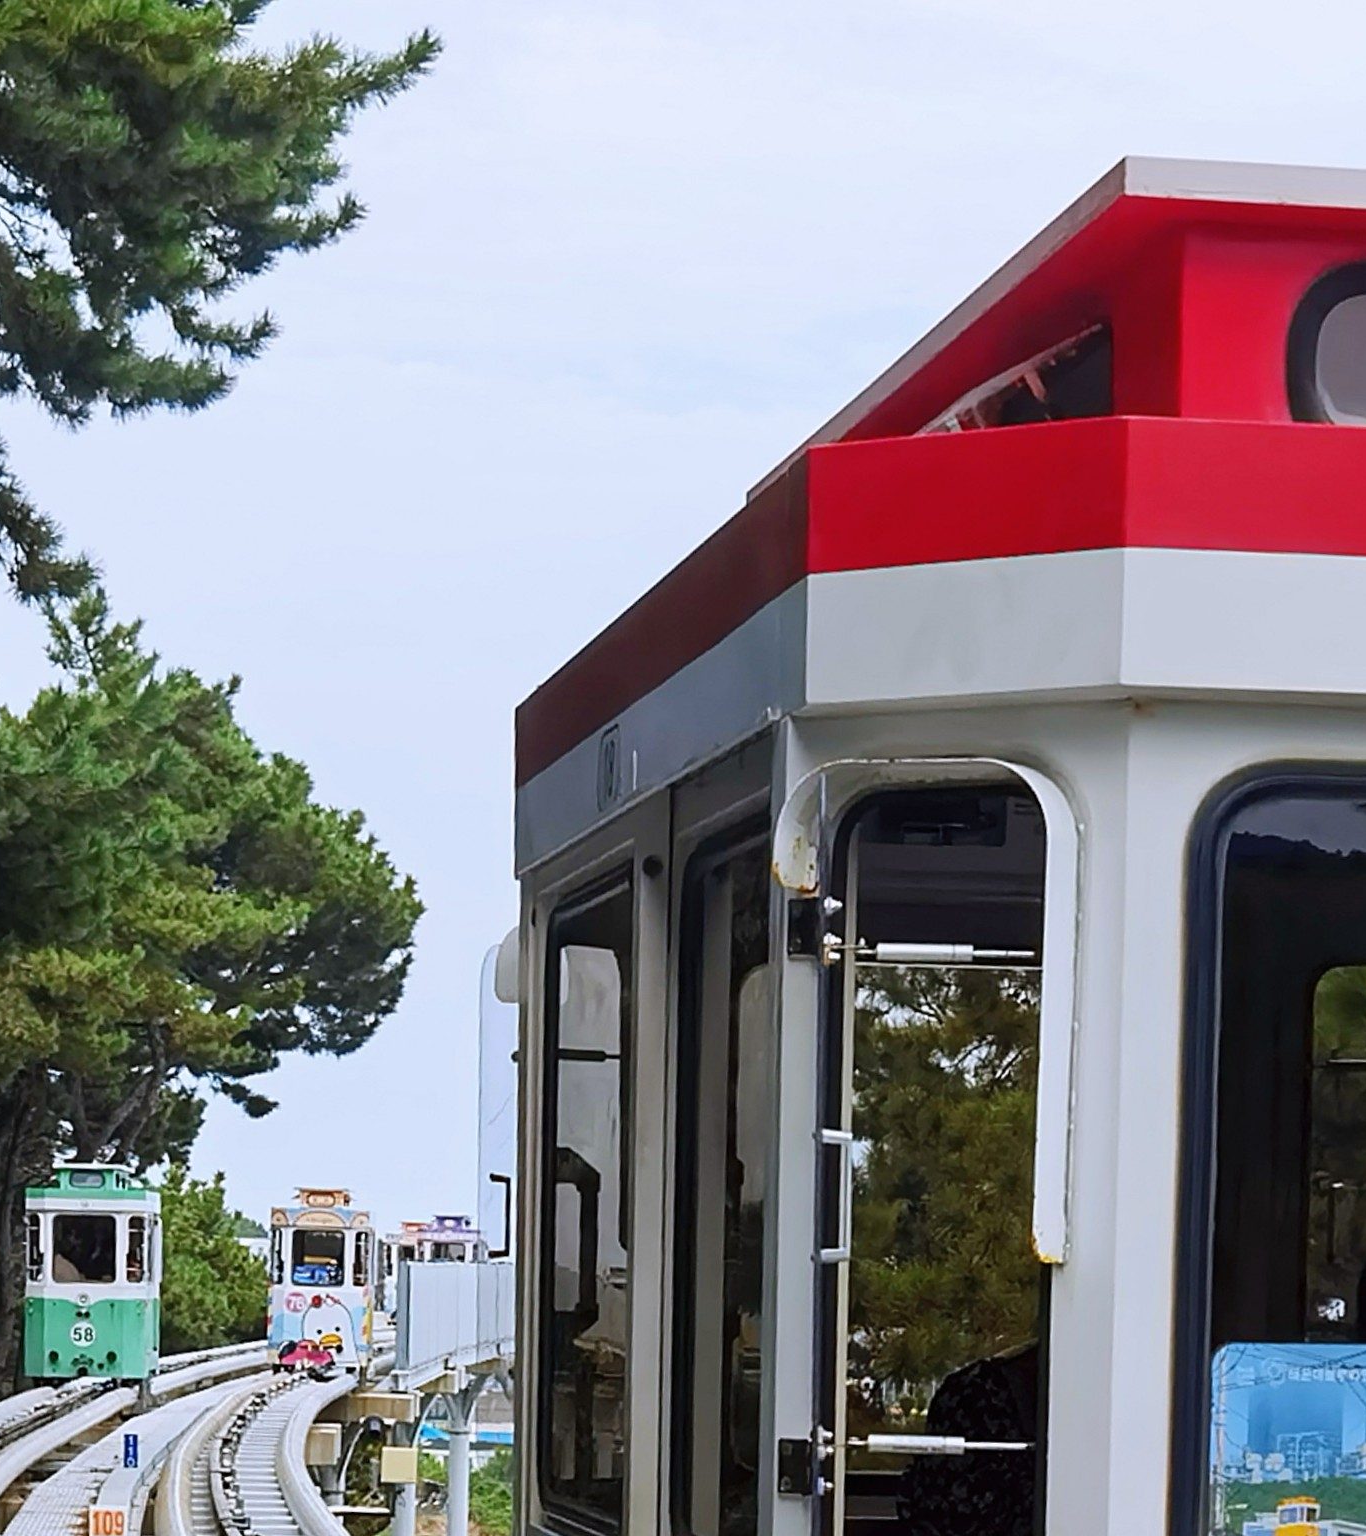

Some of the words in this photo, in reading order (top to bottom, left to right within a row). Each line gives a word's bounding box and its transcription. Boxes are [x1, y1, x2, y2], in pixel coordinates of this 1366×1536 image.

[73, 1326, 94, 1343] 58
[127, 1435, 136, 1467] 110
[93, 1510, 125, 1536] 109
